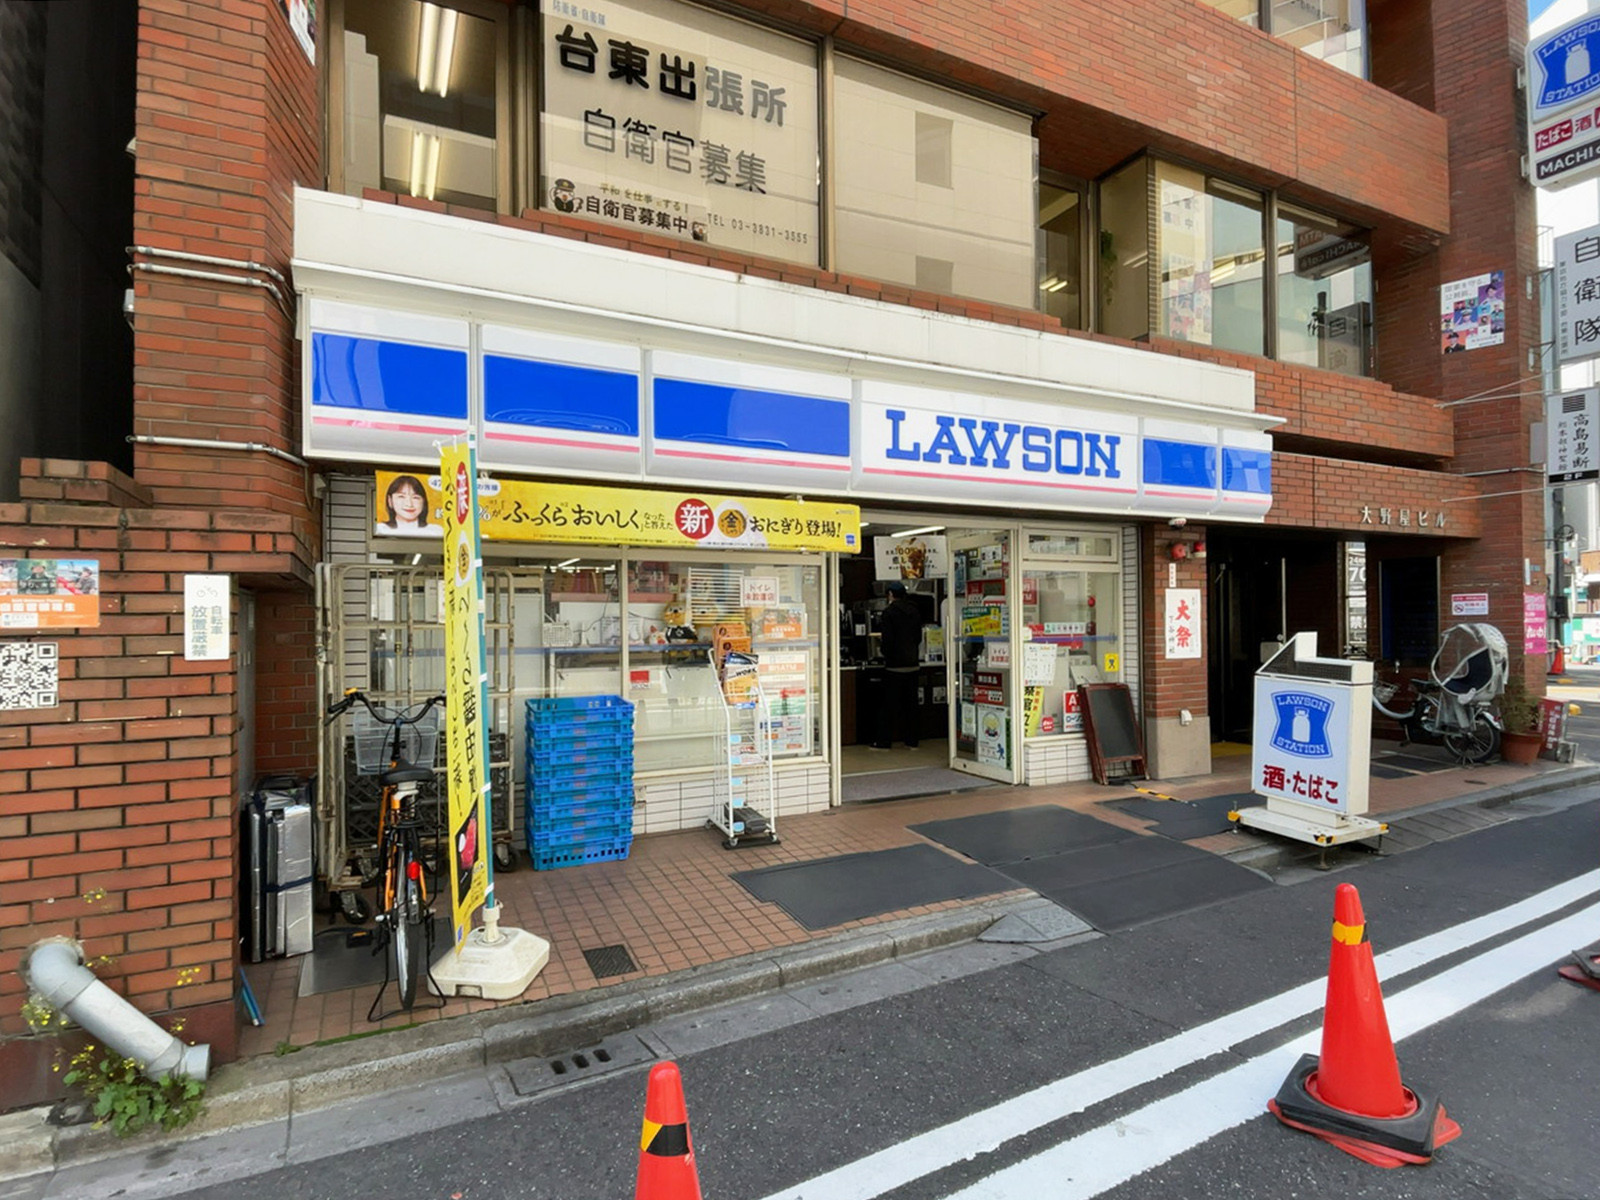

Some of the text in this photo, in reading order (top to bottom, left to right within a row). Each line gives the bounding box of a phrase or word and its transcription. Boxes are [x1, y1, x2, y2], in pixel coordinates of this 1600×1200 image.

[1543, 22, 1600, 58] LAWSO
[555, 24, 787, 127] 台東出張所
[1545, 73, 1600, 102] STATIO
[1537, 114, 1592, 149] たばこ 酒
[584, 108, 767, 194] 自衛官募集
[1540, 146, 1593, 176] MACHI
[585, 195, 688, 233] 自衛官募集中
[707, 212, 725, 227] TEL
[1574, 236, 1600, 346] 自衛隊
[886, 409, 1121, 478] LAWSON
[680, 503, 710, 535] 新
[724, 511, 742, 528] 金
[749, 515, 842, 539] おにぎり登場!
[1361, 505, 1447, 528] 大野屋ビル
[1175, 598, 1193, 649] 大祭
[1277, 695, 1329, 712] LAWSON
[1276, 736, 1325, 754] STATION
[1262, 764, 1339, 804] 酒・たばこ
